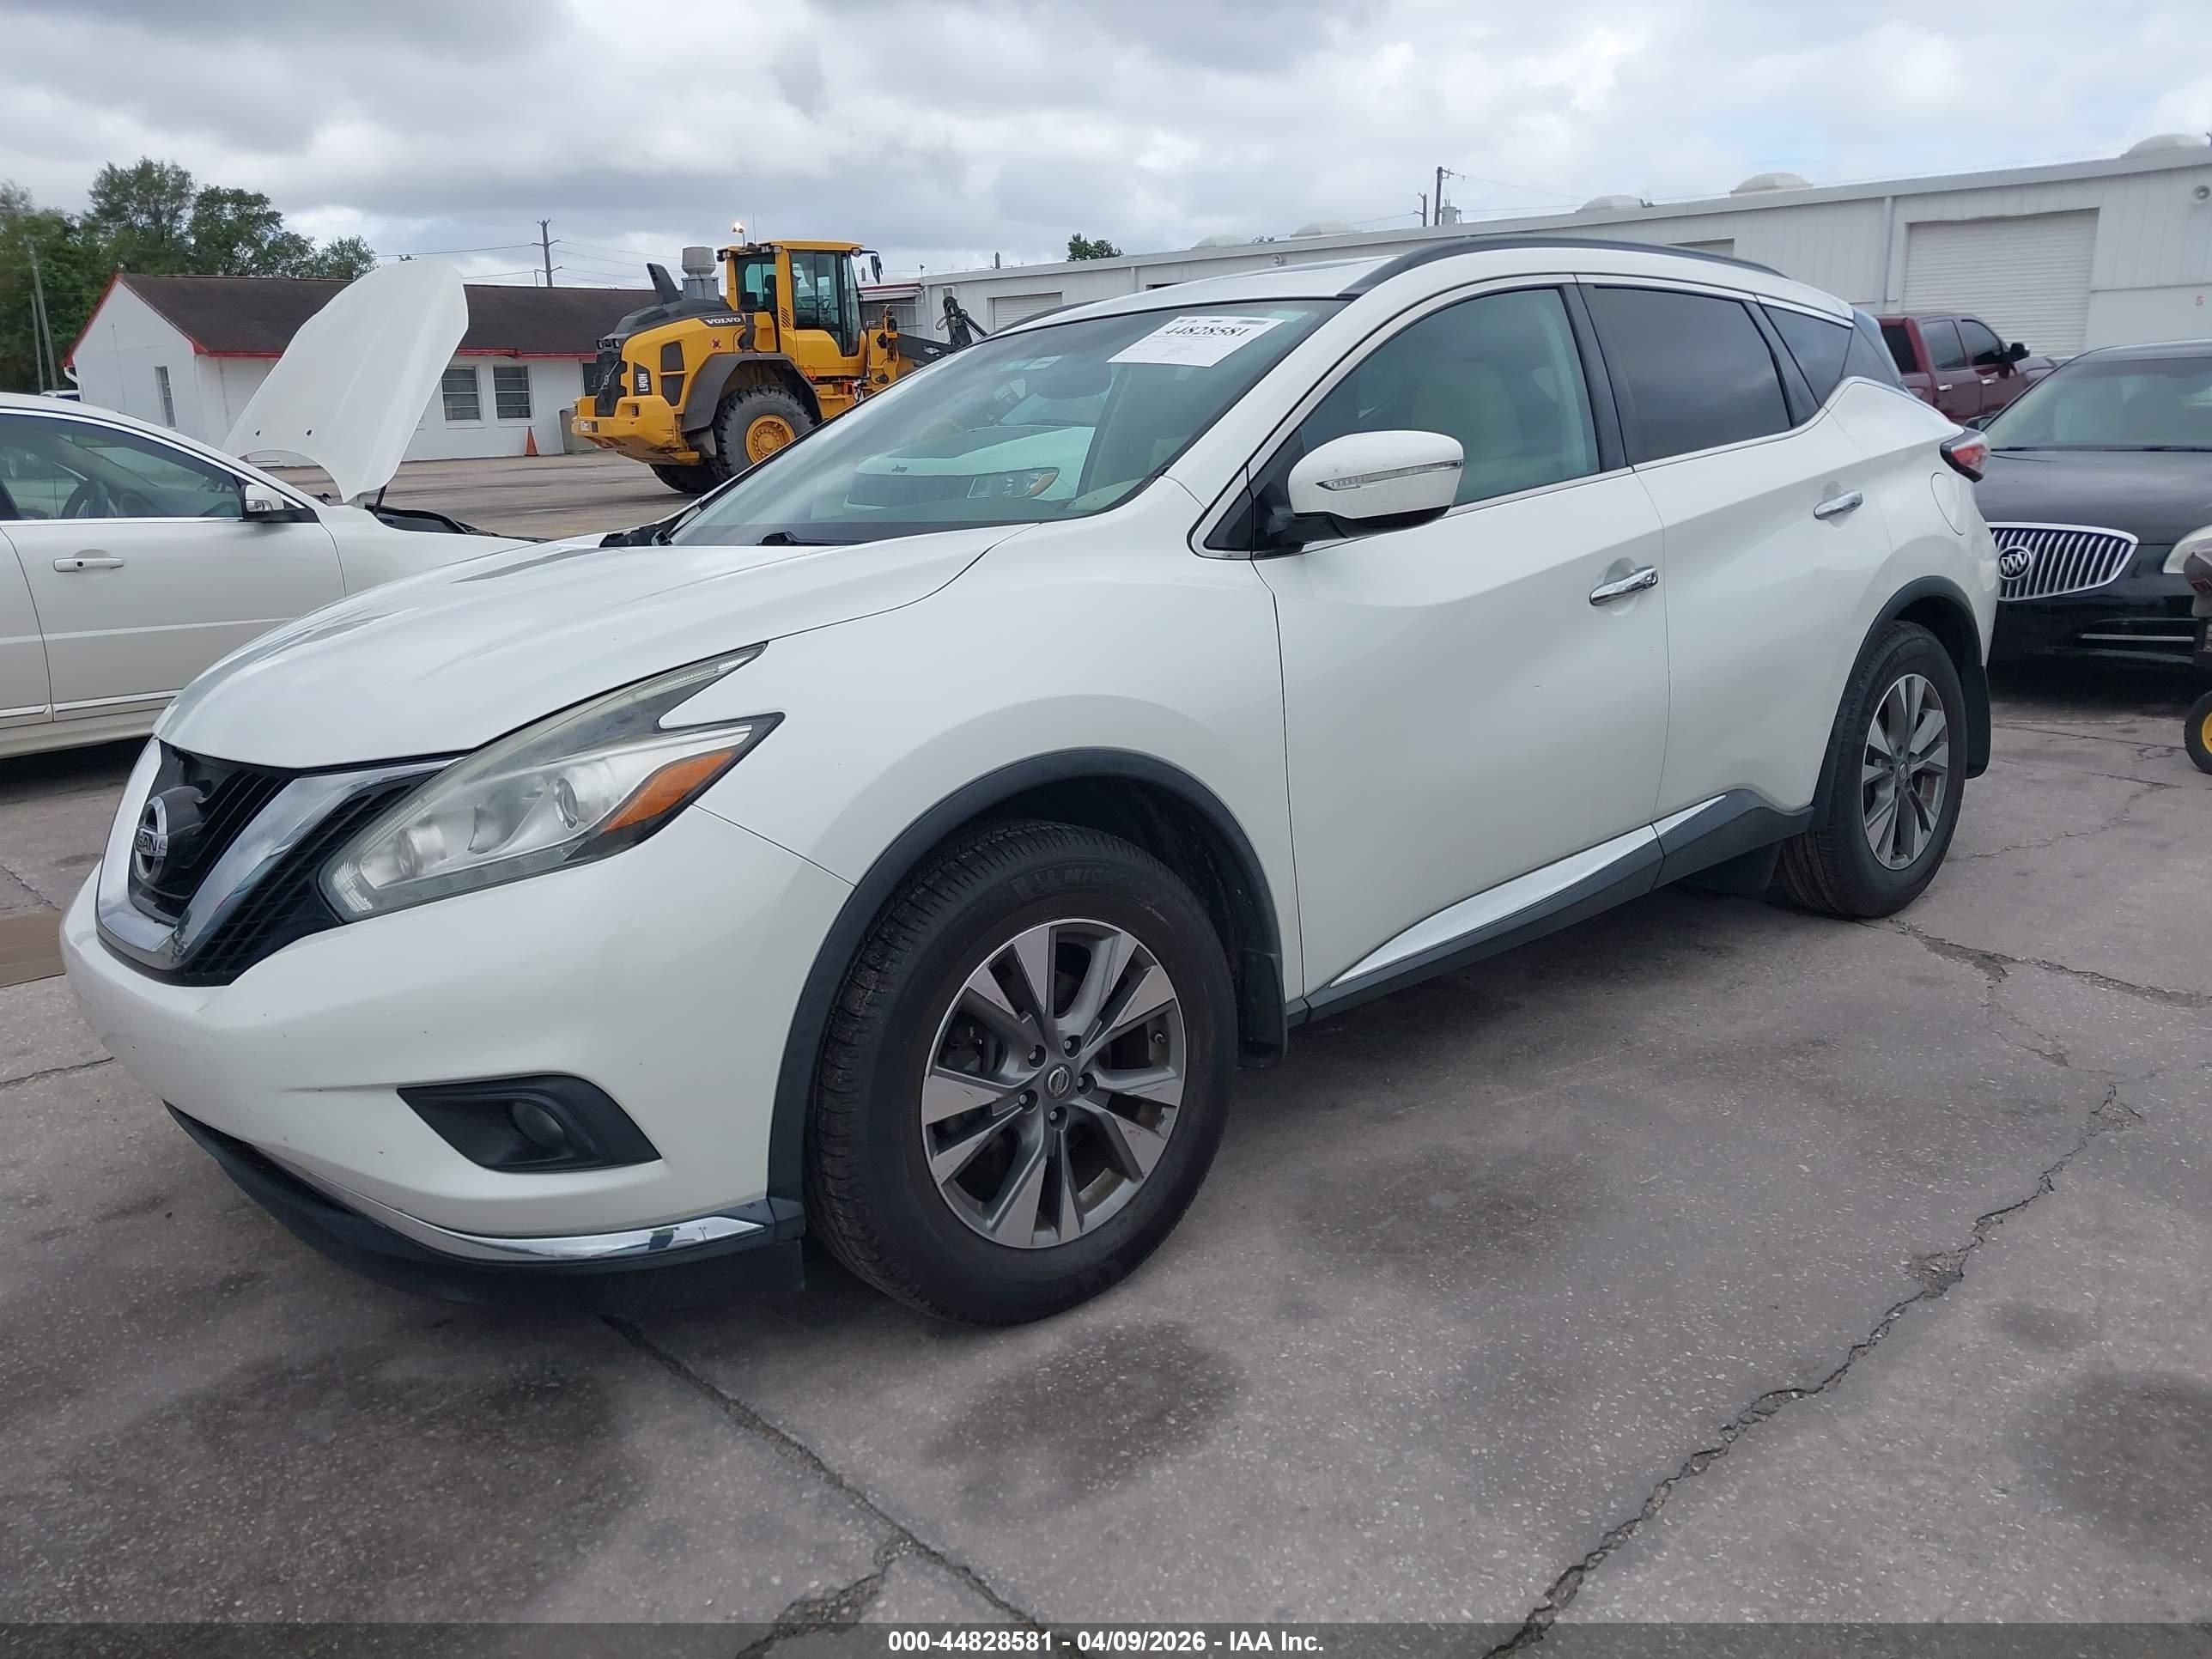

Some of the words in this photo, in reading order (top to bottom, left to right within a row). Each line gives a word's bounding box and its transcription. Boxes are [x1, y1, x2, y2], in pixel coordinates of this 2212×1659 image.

[2195, 295, 2204, 307] 5
[1165, 325, 1251, 337] 44828581
[638, 374, 649, 392] L90H
